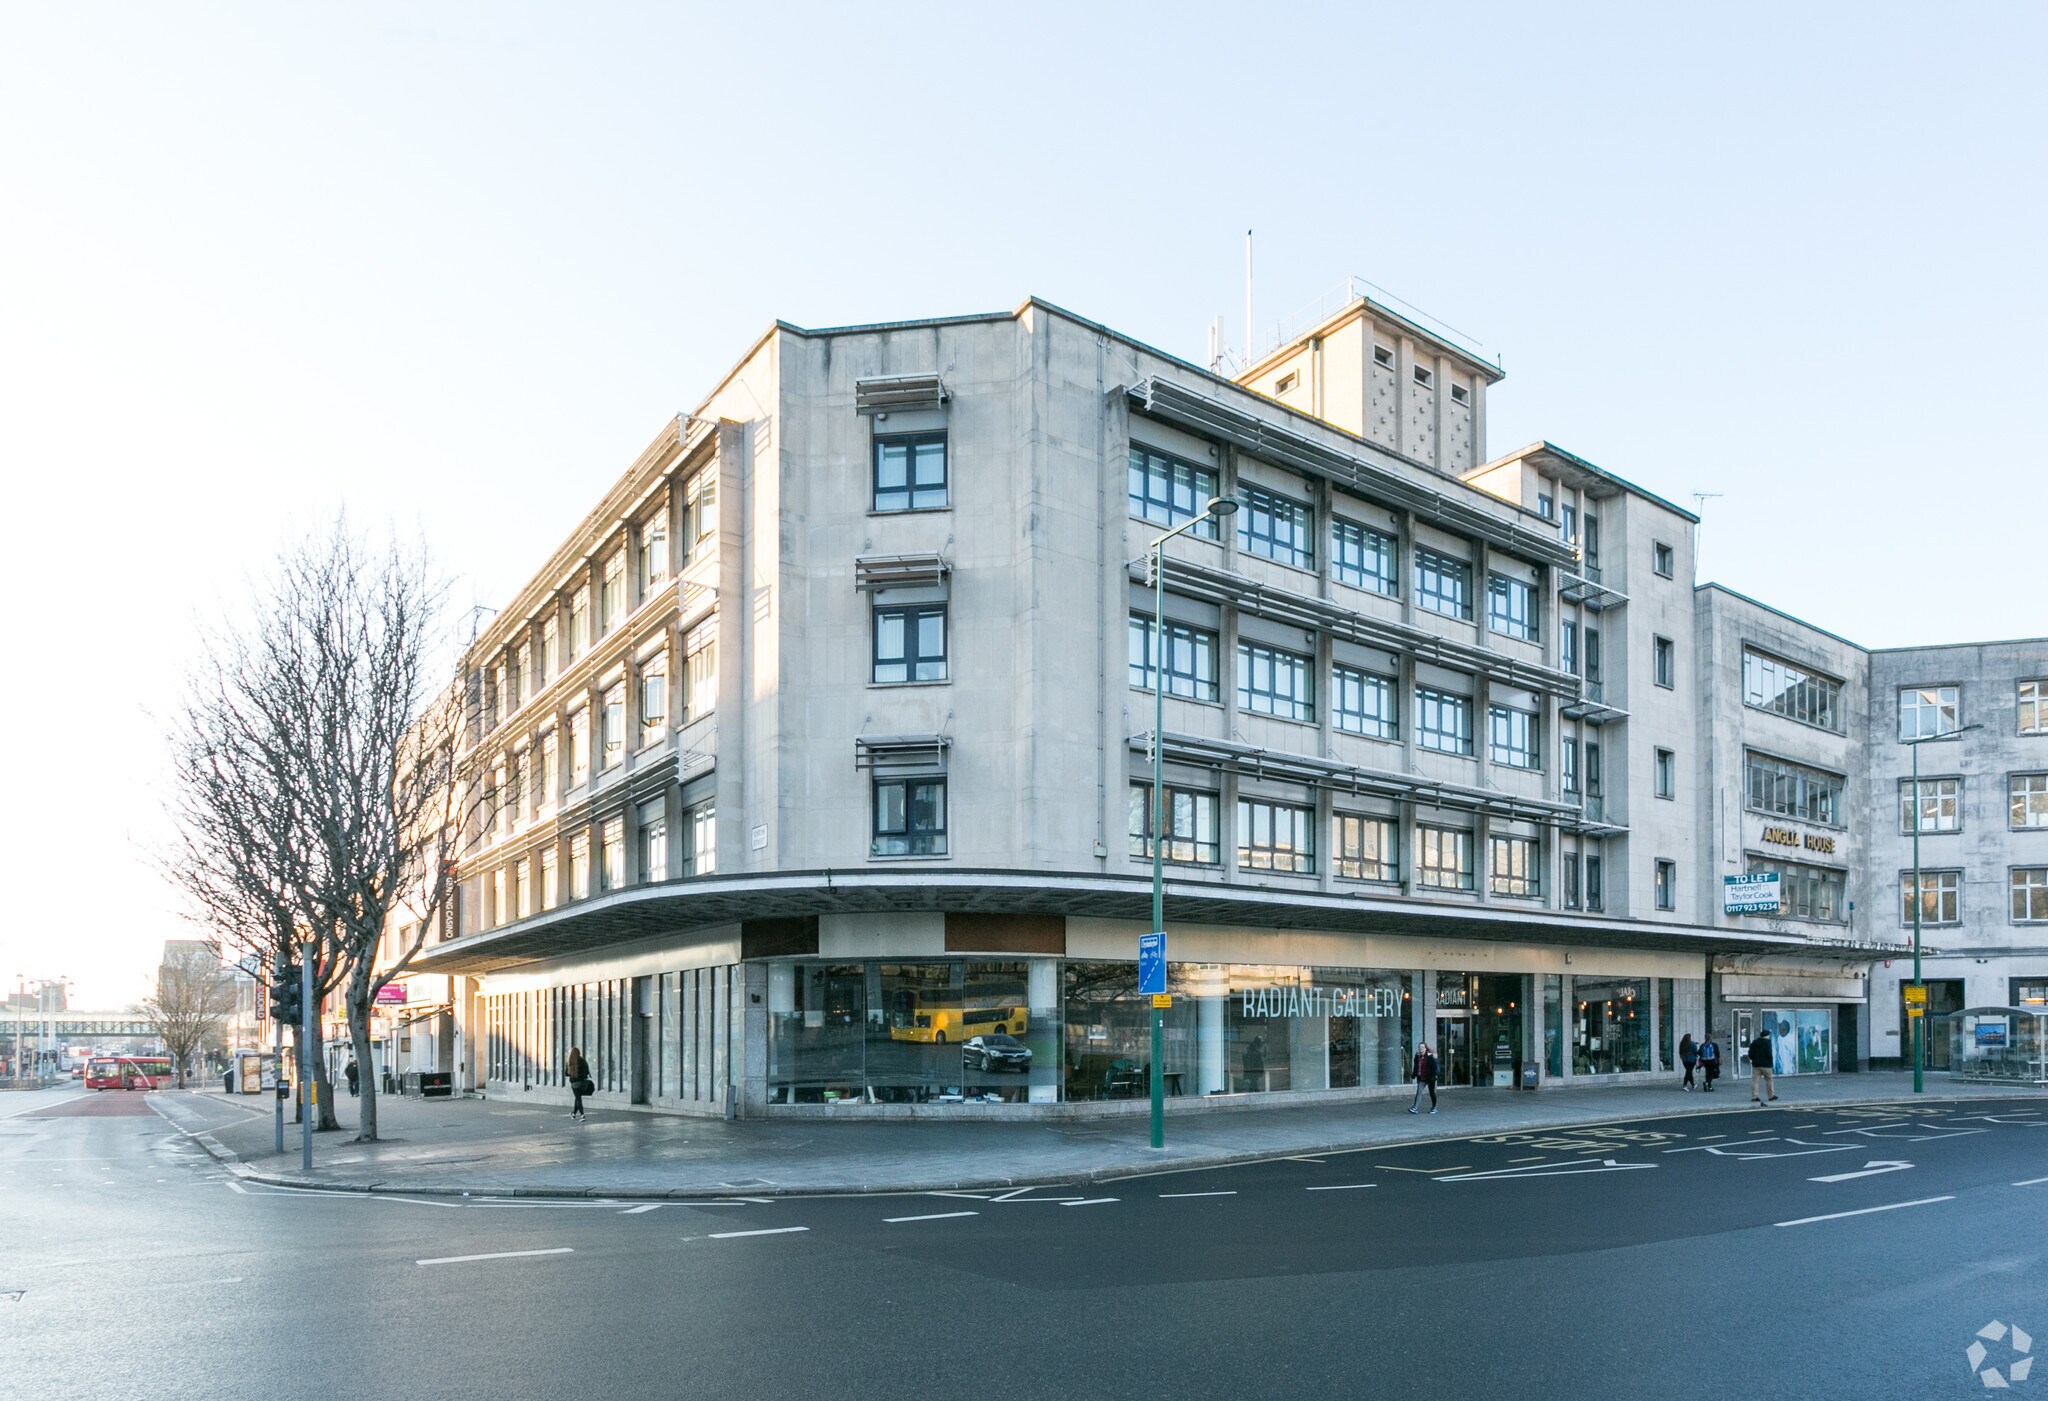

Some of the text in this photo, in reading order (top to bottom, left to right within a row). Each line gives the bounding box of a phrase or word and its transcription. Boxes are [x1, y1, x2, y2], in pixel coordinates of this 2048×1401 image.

[1764, 827, 1836, 853] ANGLIA HOUSE
[1734, 873, 1770, 884] TO LET
[1730, 883, 1762, 892] Hartnell
[1730, 891, 1774, 901] Taylor Cook
[1726, 902, 1778, 913] 0117 923 9234
[445, 910, 454, 939] CASINO
[1243, 986, 1404, 1018] RADIANT GALLERY
[1562, 1127, 1687, 1141] BUS
[1469, 1134, 1629, 1151] STOP
